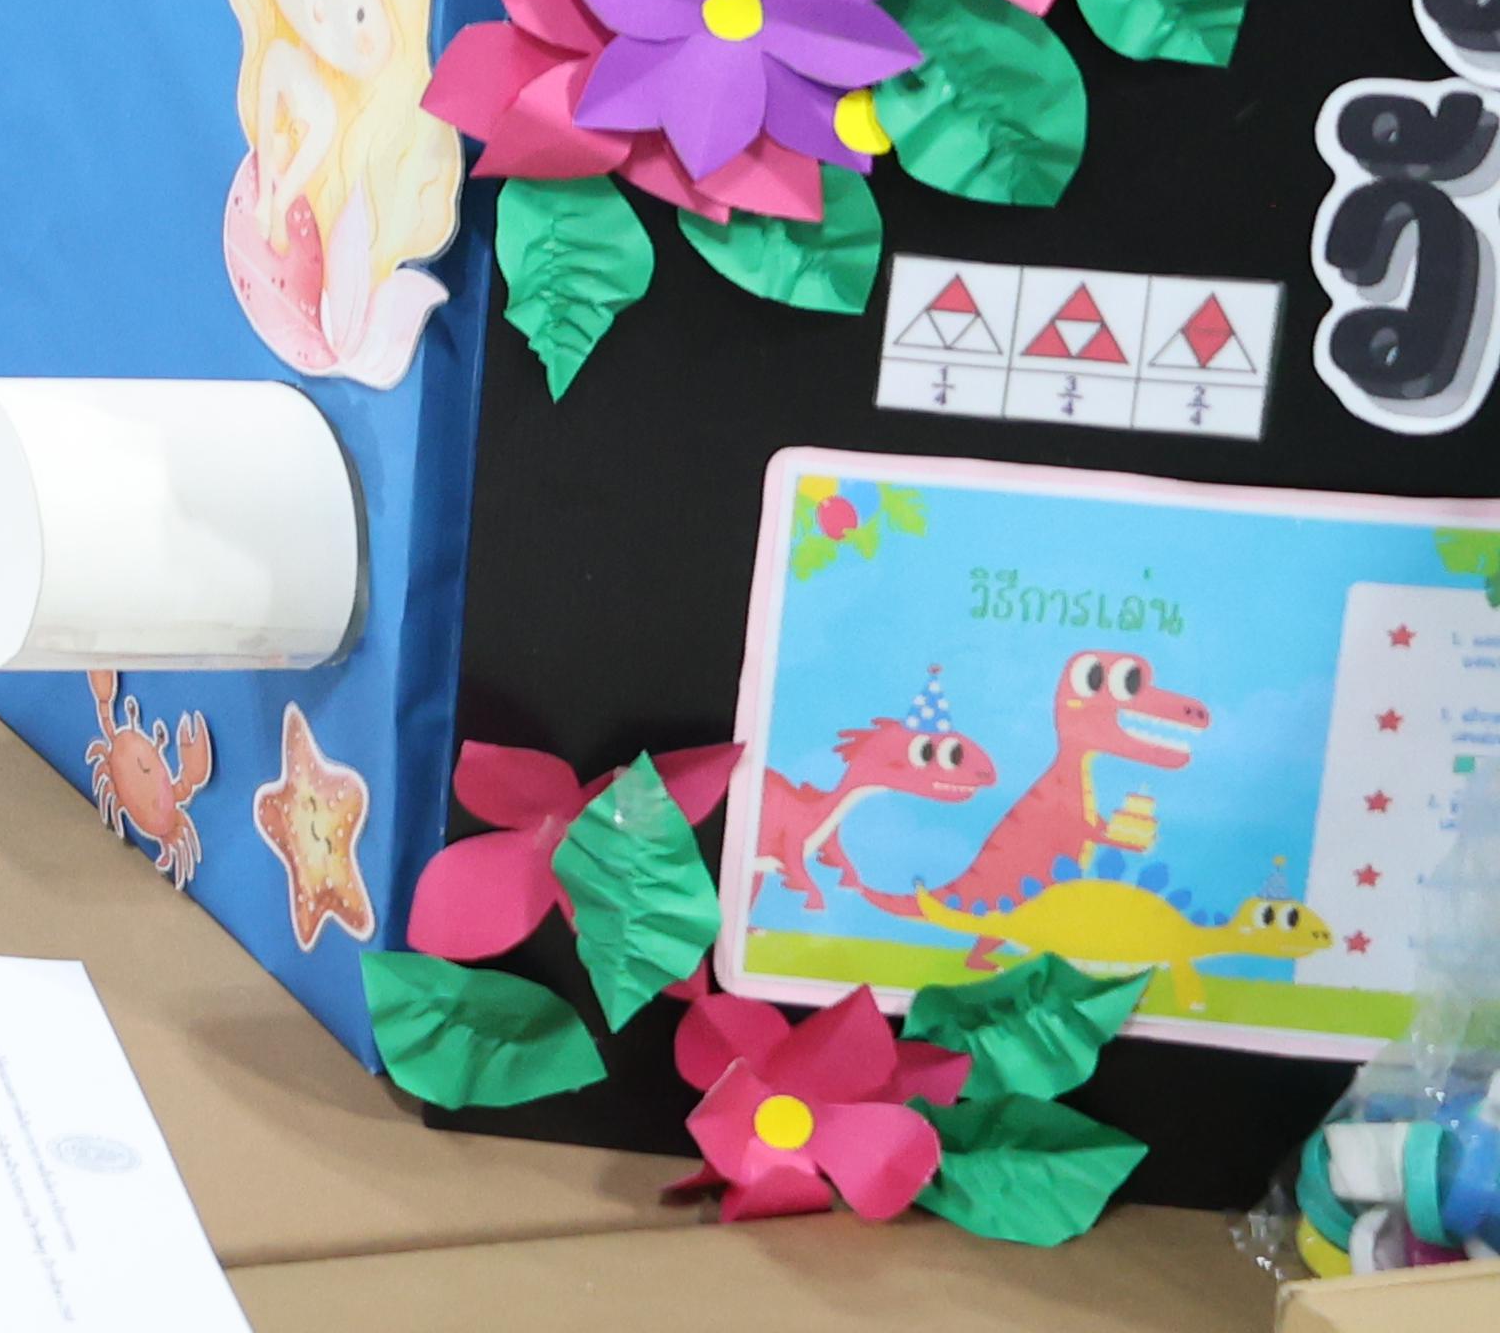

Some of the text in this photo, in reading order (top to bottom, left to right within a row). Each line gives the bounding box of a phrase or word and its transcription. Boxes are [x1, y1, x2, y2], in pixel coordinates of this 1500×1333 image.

[968, 566, 1185, 635] วิธีการเล่น
